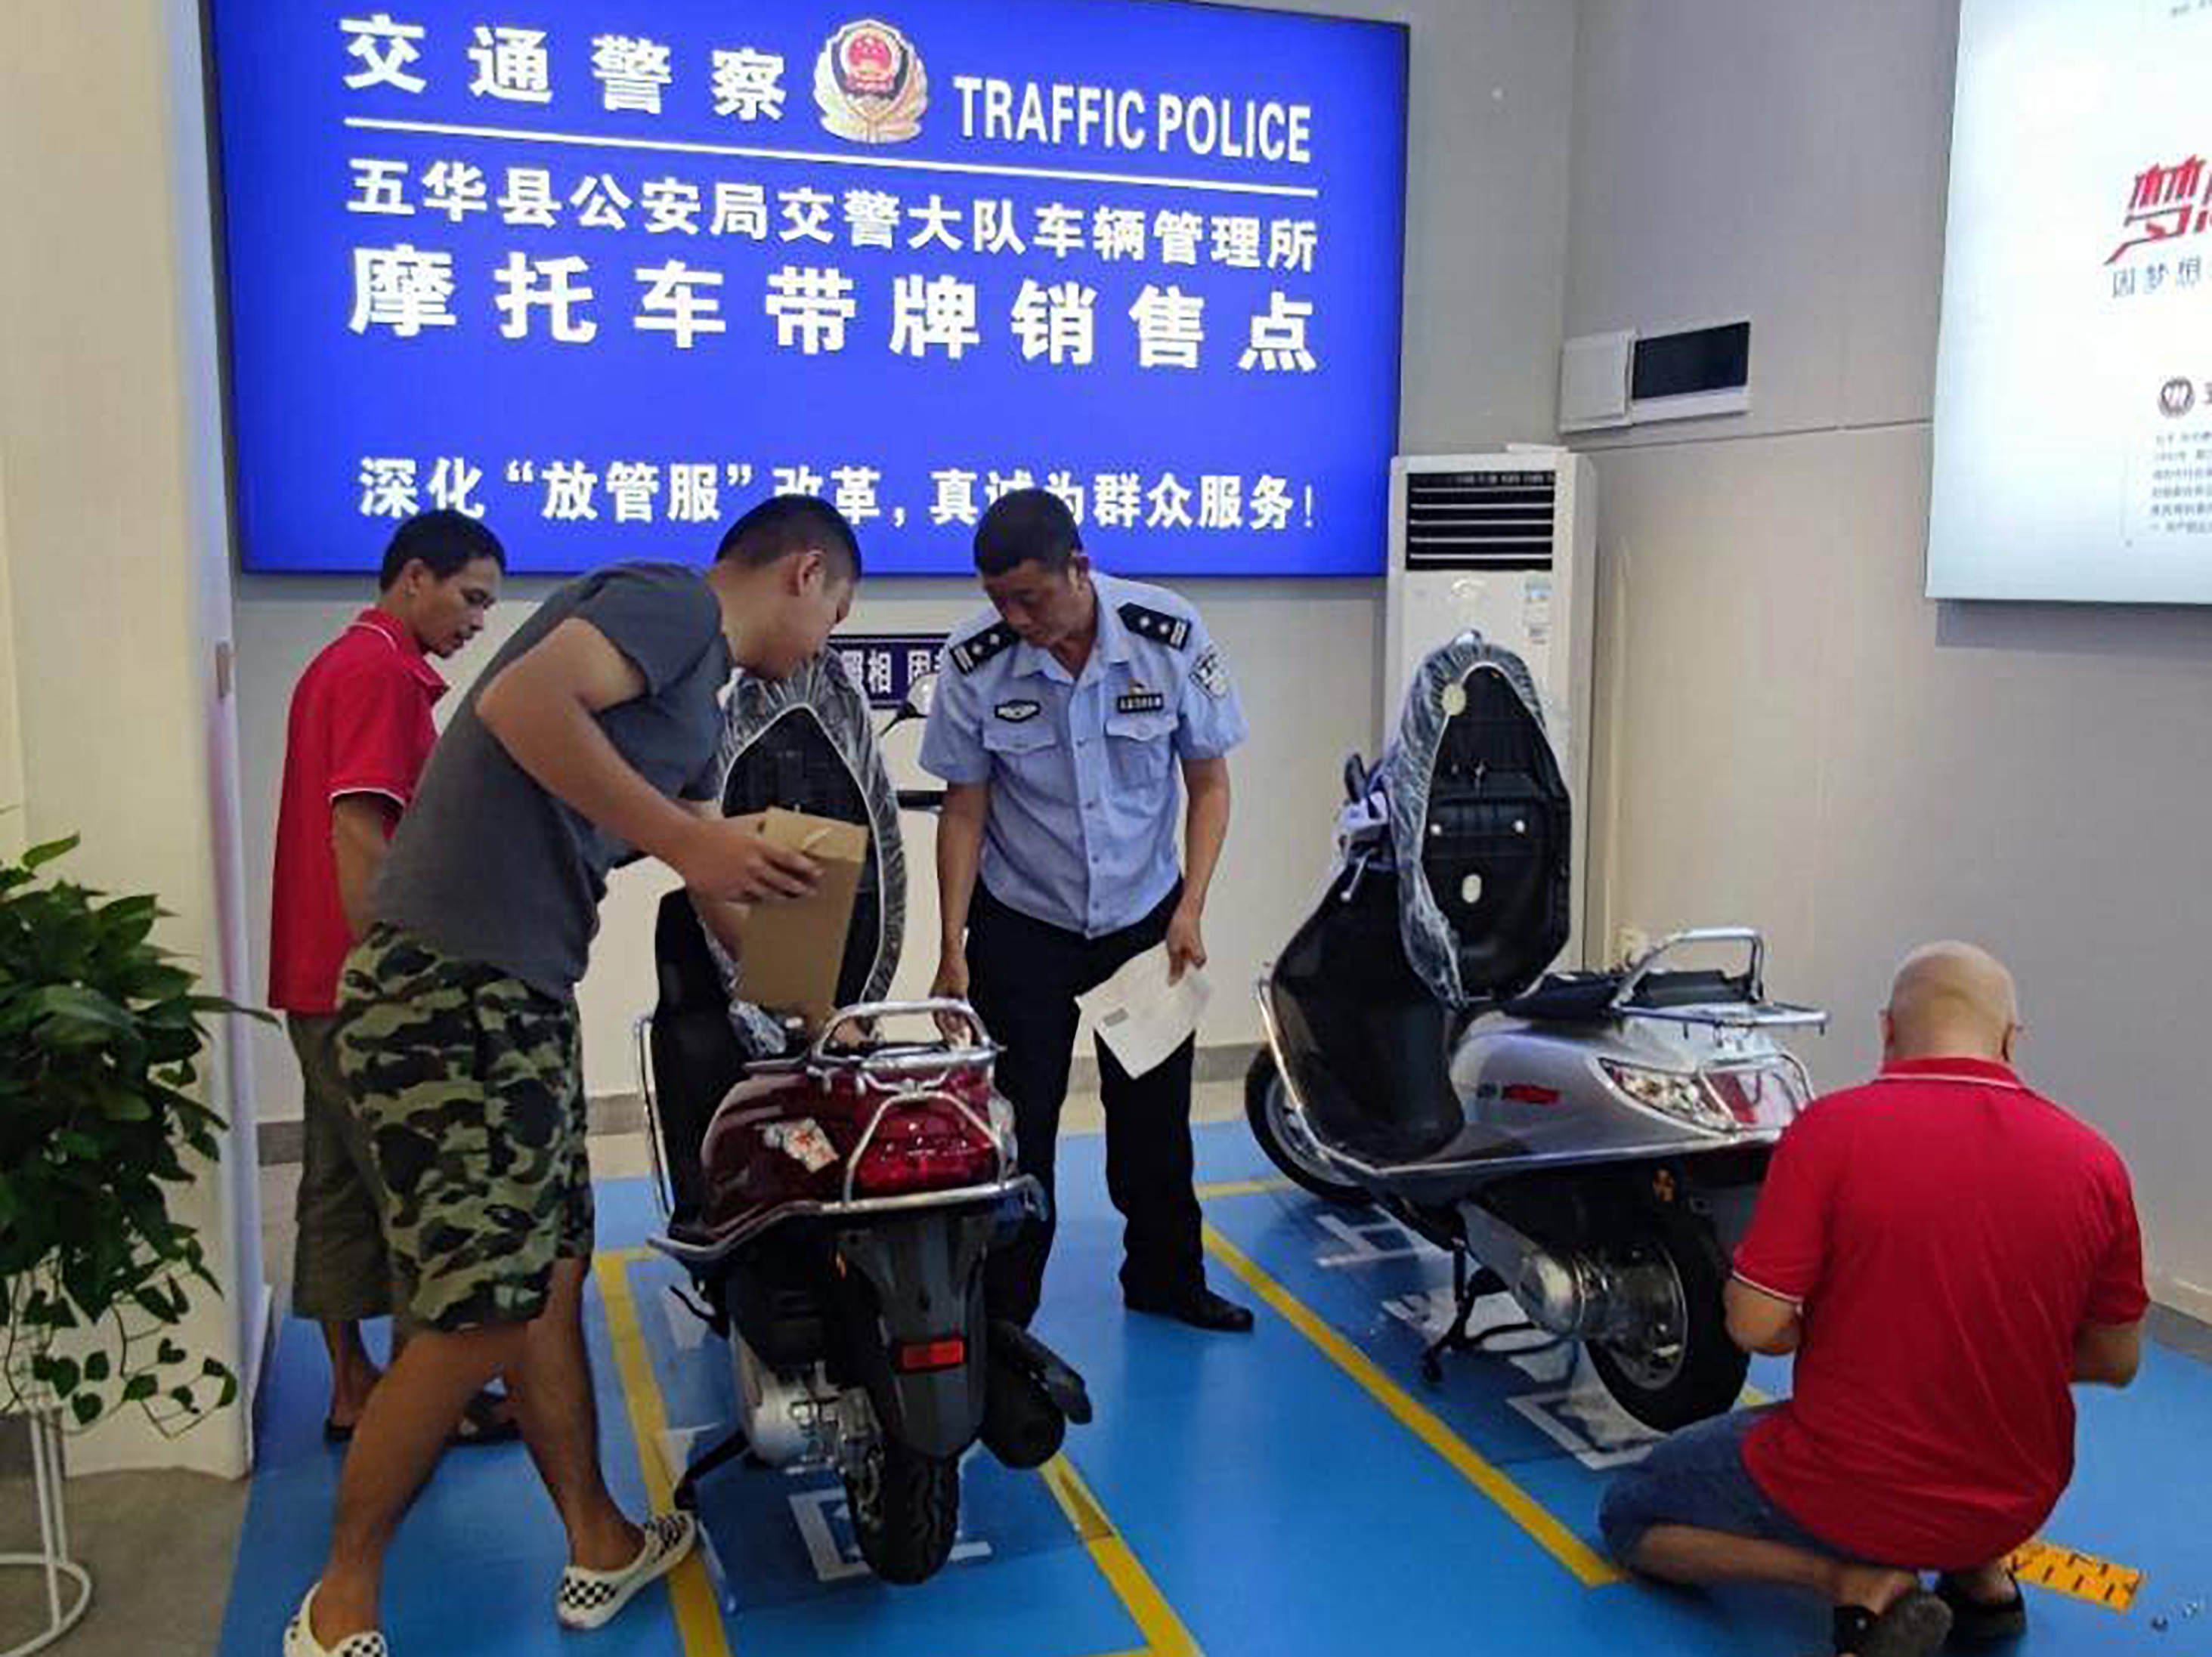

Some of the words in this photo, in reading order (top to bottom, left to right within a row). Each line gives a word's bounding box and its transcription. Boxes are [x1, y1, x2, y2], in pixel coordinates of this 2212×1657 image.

[339, 14, 787, 121] 交通警察
[953, 75, 1145, 150] TRAFFIC
[1159, 94, 1311, 164] POLICE
[347, 158, 1318, 273] 五华县公安局交警大队车辆管理所
[348, 243, 1316, 373] 摩托车带牌销售点
